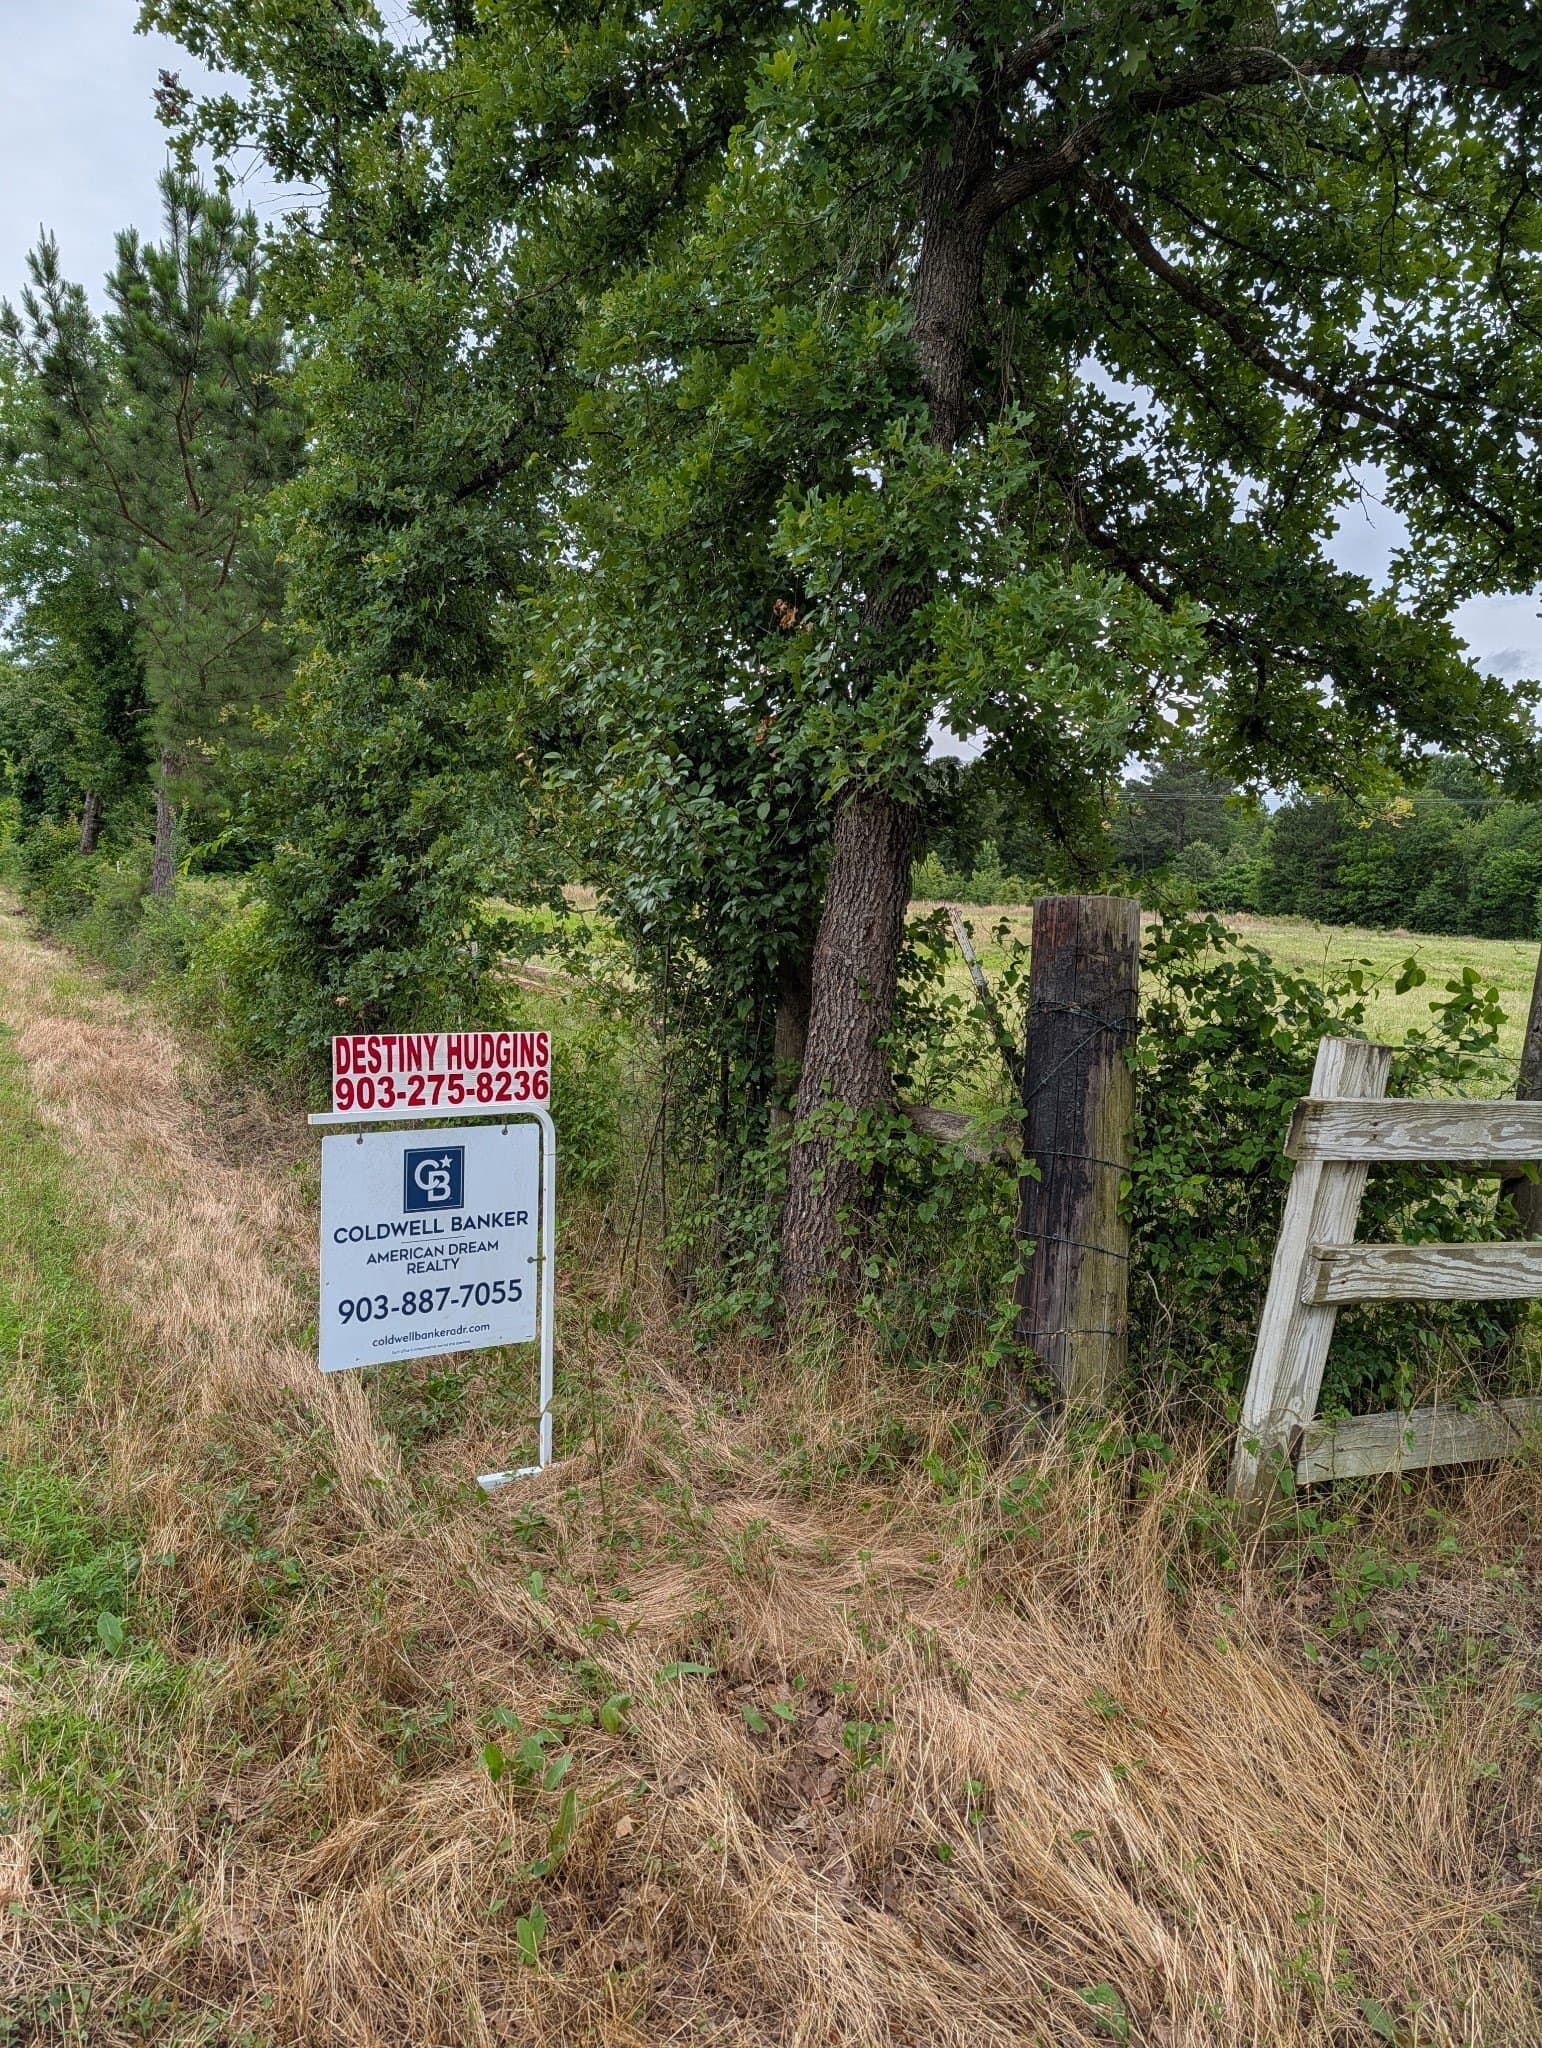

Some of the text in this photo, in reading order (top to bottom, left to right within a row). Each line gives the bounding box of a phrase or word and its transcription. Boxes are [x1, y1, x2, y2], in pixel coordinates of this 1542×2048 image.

[335, 1032, 549, 1075] DESTINY HUDGINS
[335, 1069, 549, 1111] 903-275-8236
[333, 1210, 529, 1244] COLDWELL BANKER
[367, 1240, 499, 1265] AMERICAN DREAM
[406, 1257, 461, 1275] REALTY
[338, 1278, 523, 1325] 903-887-7055
[372, 1323, 490, 1347] coldwellbankeradr.com
